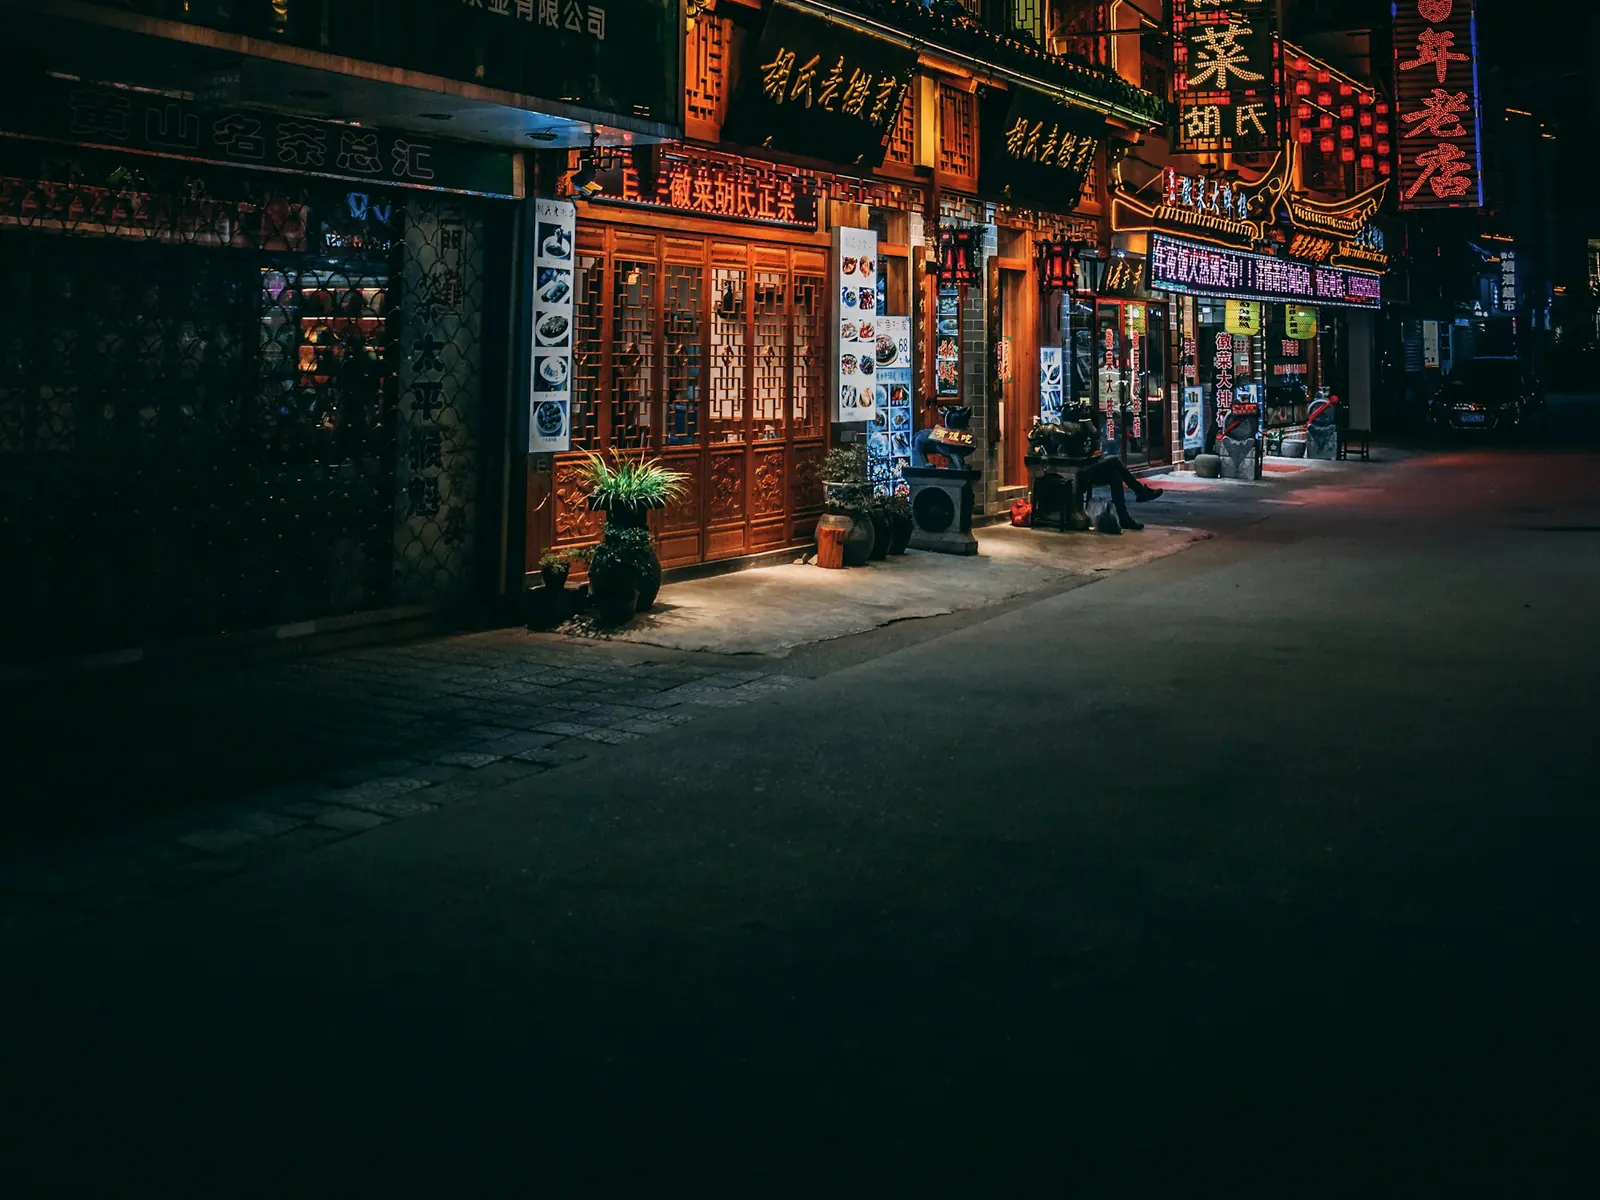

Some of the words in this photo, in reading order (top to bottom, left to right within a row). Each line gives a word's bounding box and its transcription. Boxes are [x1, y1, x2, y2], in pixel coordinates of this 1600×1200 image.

[69, 88, 434, 179] 黄山名茶总汇
[1184, 103, 1268, 136] 胡氏
